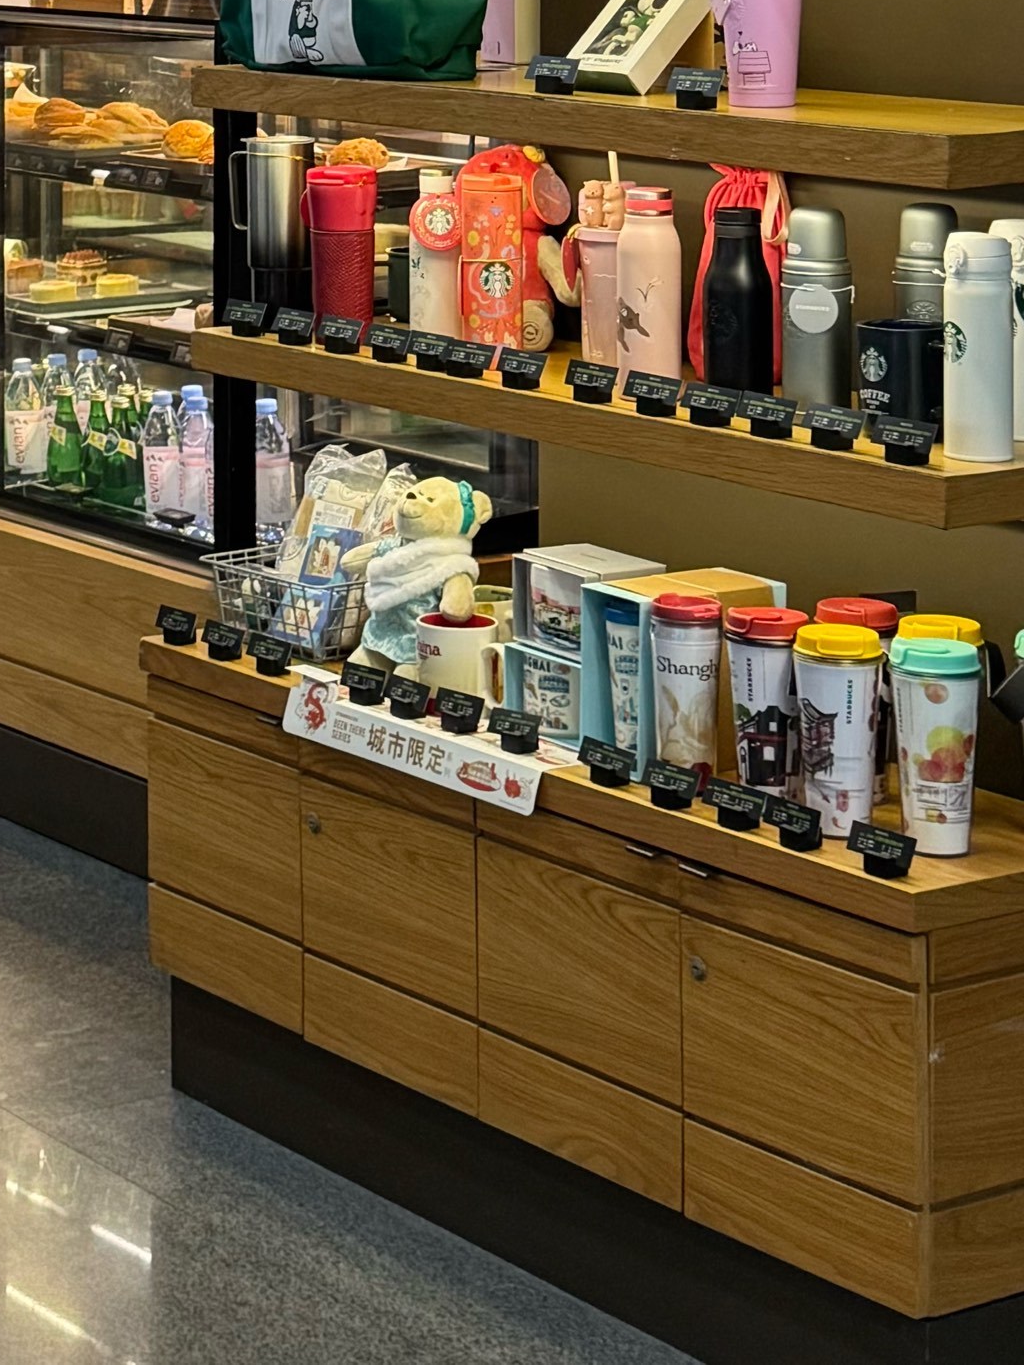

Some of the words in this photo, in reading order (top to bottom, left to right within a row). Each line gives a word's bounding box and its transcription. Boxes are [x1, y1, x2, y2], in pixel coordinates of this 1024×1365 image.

[860, 388, 890, 403] COFFEE
[14, 426, 26, 465] evian
[148, 463, 160, 504] evian
[746, 657, 754, 702] STARBUCKS
[846, 678, 854, 725] STARBUCKS
[366, 722, 447, 775] 城市限定
